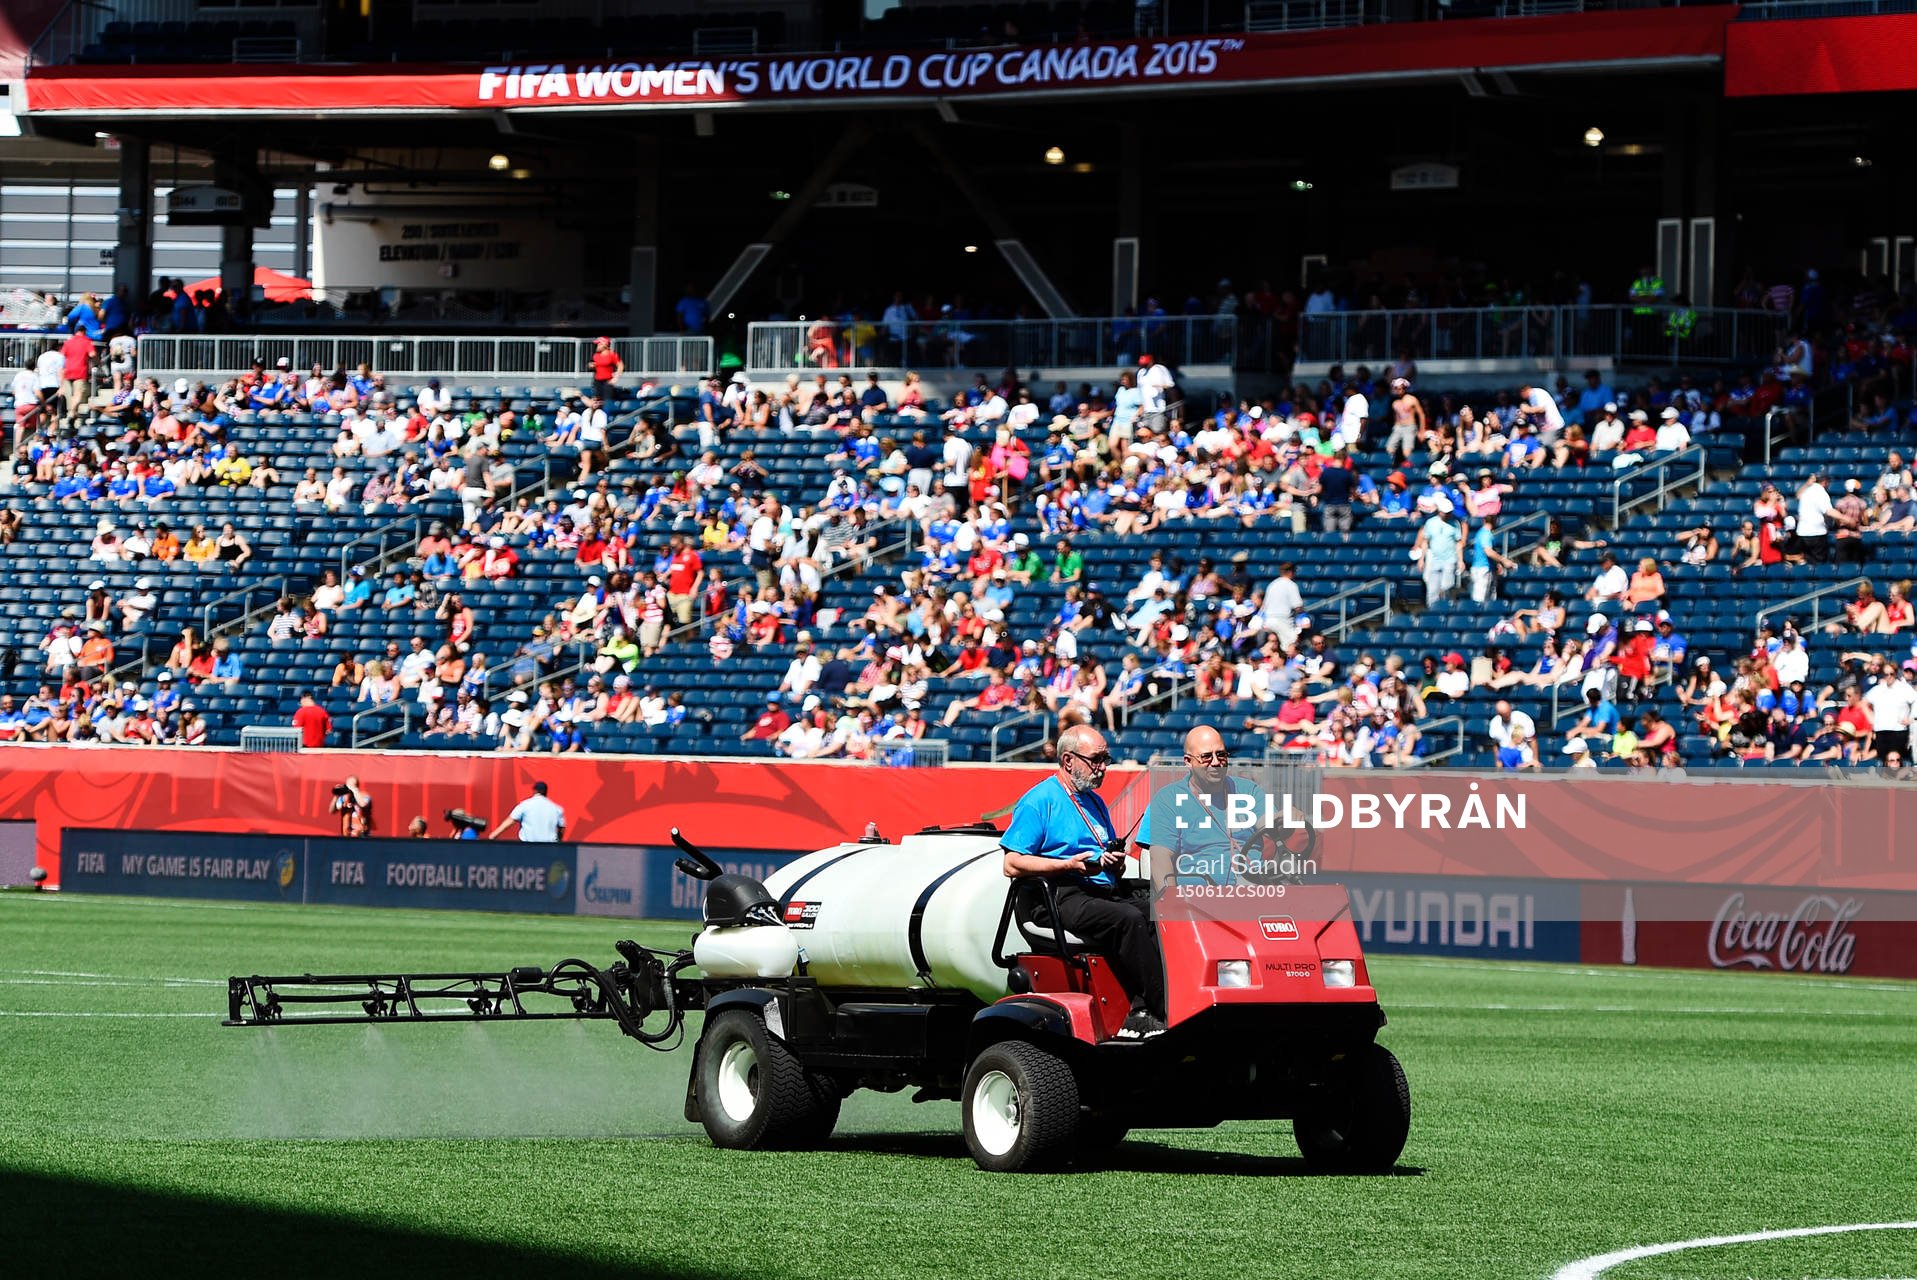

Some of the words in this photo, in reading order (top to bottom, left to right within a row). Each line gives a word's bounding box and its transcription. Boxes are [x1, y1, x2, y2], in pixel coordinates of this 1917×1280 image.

[479, 65, 571, 99] FIFA
[576, 61, 760, 98] WOMEN'S
[768, 55, 912, 92] WORLD
[918, 53, 994, 89] CUP
[995, 45, 1138, 84] CANADA
[77, 852, 105, 873] FIFA
[122, 854, 149, 875] MY
[146, 855, 185, 877] GAME
[189, 858, 201, 878] IS
[204, 859, 233, 879] FAIR
[236, 860, 270, 880] PLAY
[331, 861, 364, 885] FIFA
[387, 862, 463, 888] FOOTBALL
[467, 866, 499, 889] FOR
[502, 866, 545, 891] HOPE
[1349, 888, 1535, 949] YUNDAI
[1265, 963, 1292, 971] MULTI
[1294, 963, 1317, 971] PRO
